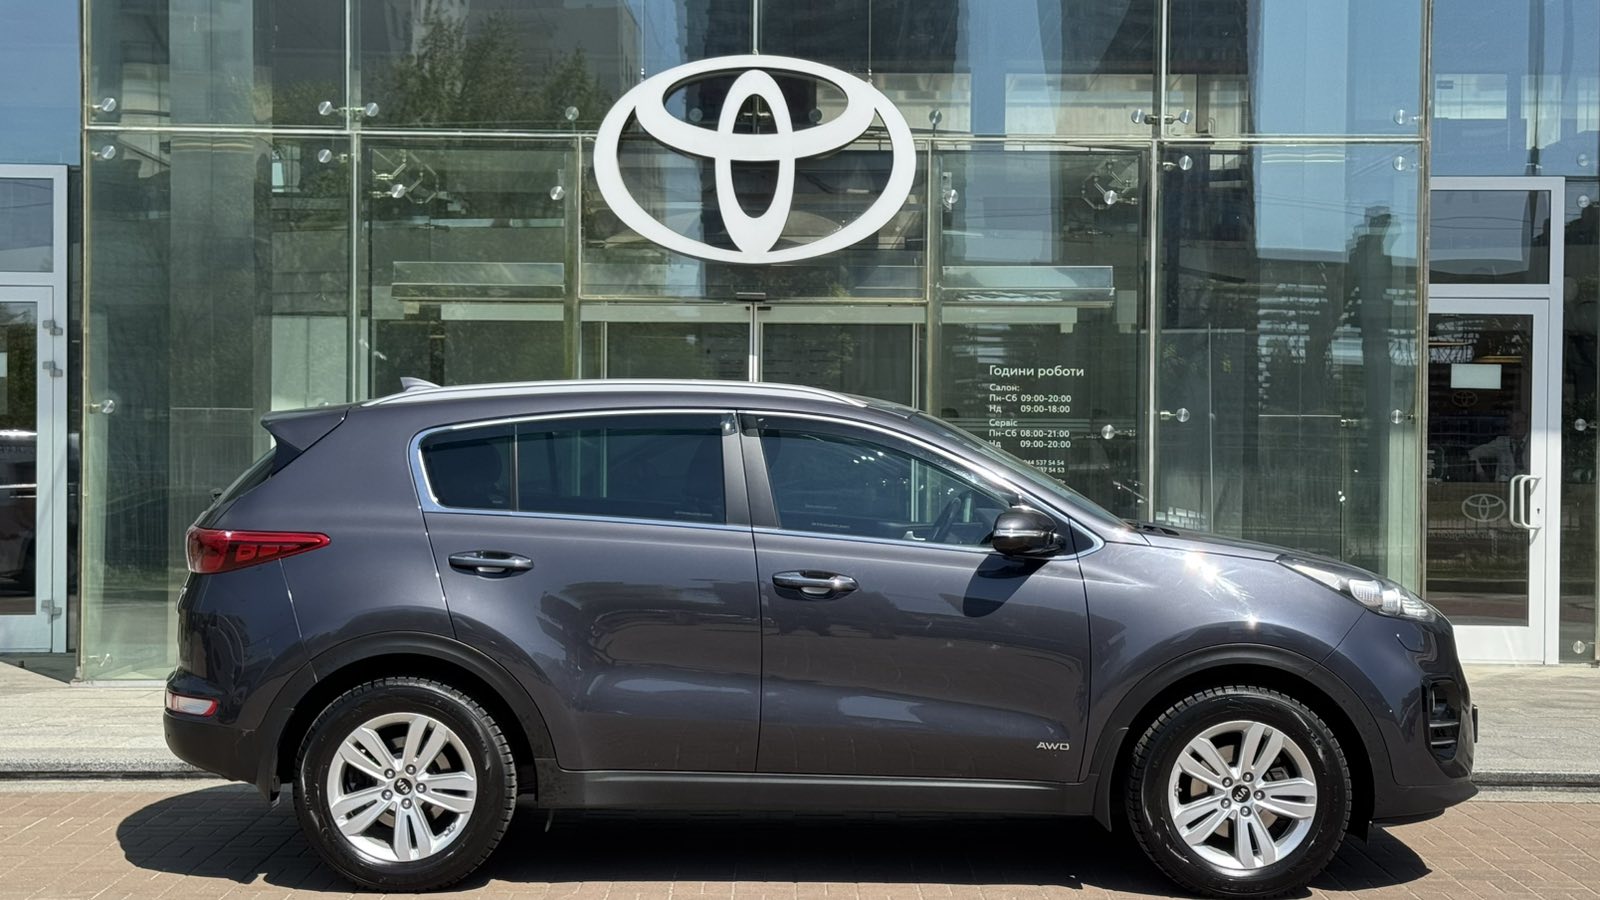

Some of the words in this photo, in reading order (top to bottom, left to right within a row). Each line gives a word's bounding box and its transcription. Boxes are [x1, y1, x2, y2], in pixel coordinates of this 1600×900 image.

[989, 365, 1034, 377] Години
[1037, 365, 1085, 378] роботи
[989, 383, 1020, 392] Салон:
[989, 394, 1018, 402] Пн-Сб
[1020, 394, 1072, 403] 09:00-20:00
[989, 404, 1002, 413] Нд
[1020, 405, 1071, 413] 09:00-18:00
[988, 419, 1018, 428] Сервіс
[988, 429, 1018, 437] Пн-Сб
[1020, 429, 1070, 438] 08:00-21:00
[1020, 440, 1071, 448] 09:00-20:00
[1057, 466, 1065, 474] 53
[1036, 741, 1070, 751] AWD
[396, 779, 410, 794] KIA
[1233, 787, 1248, 802] KIA
